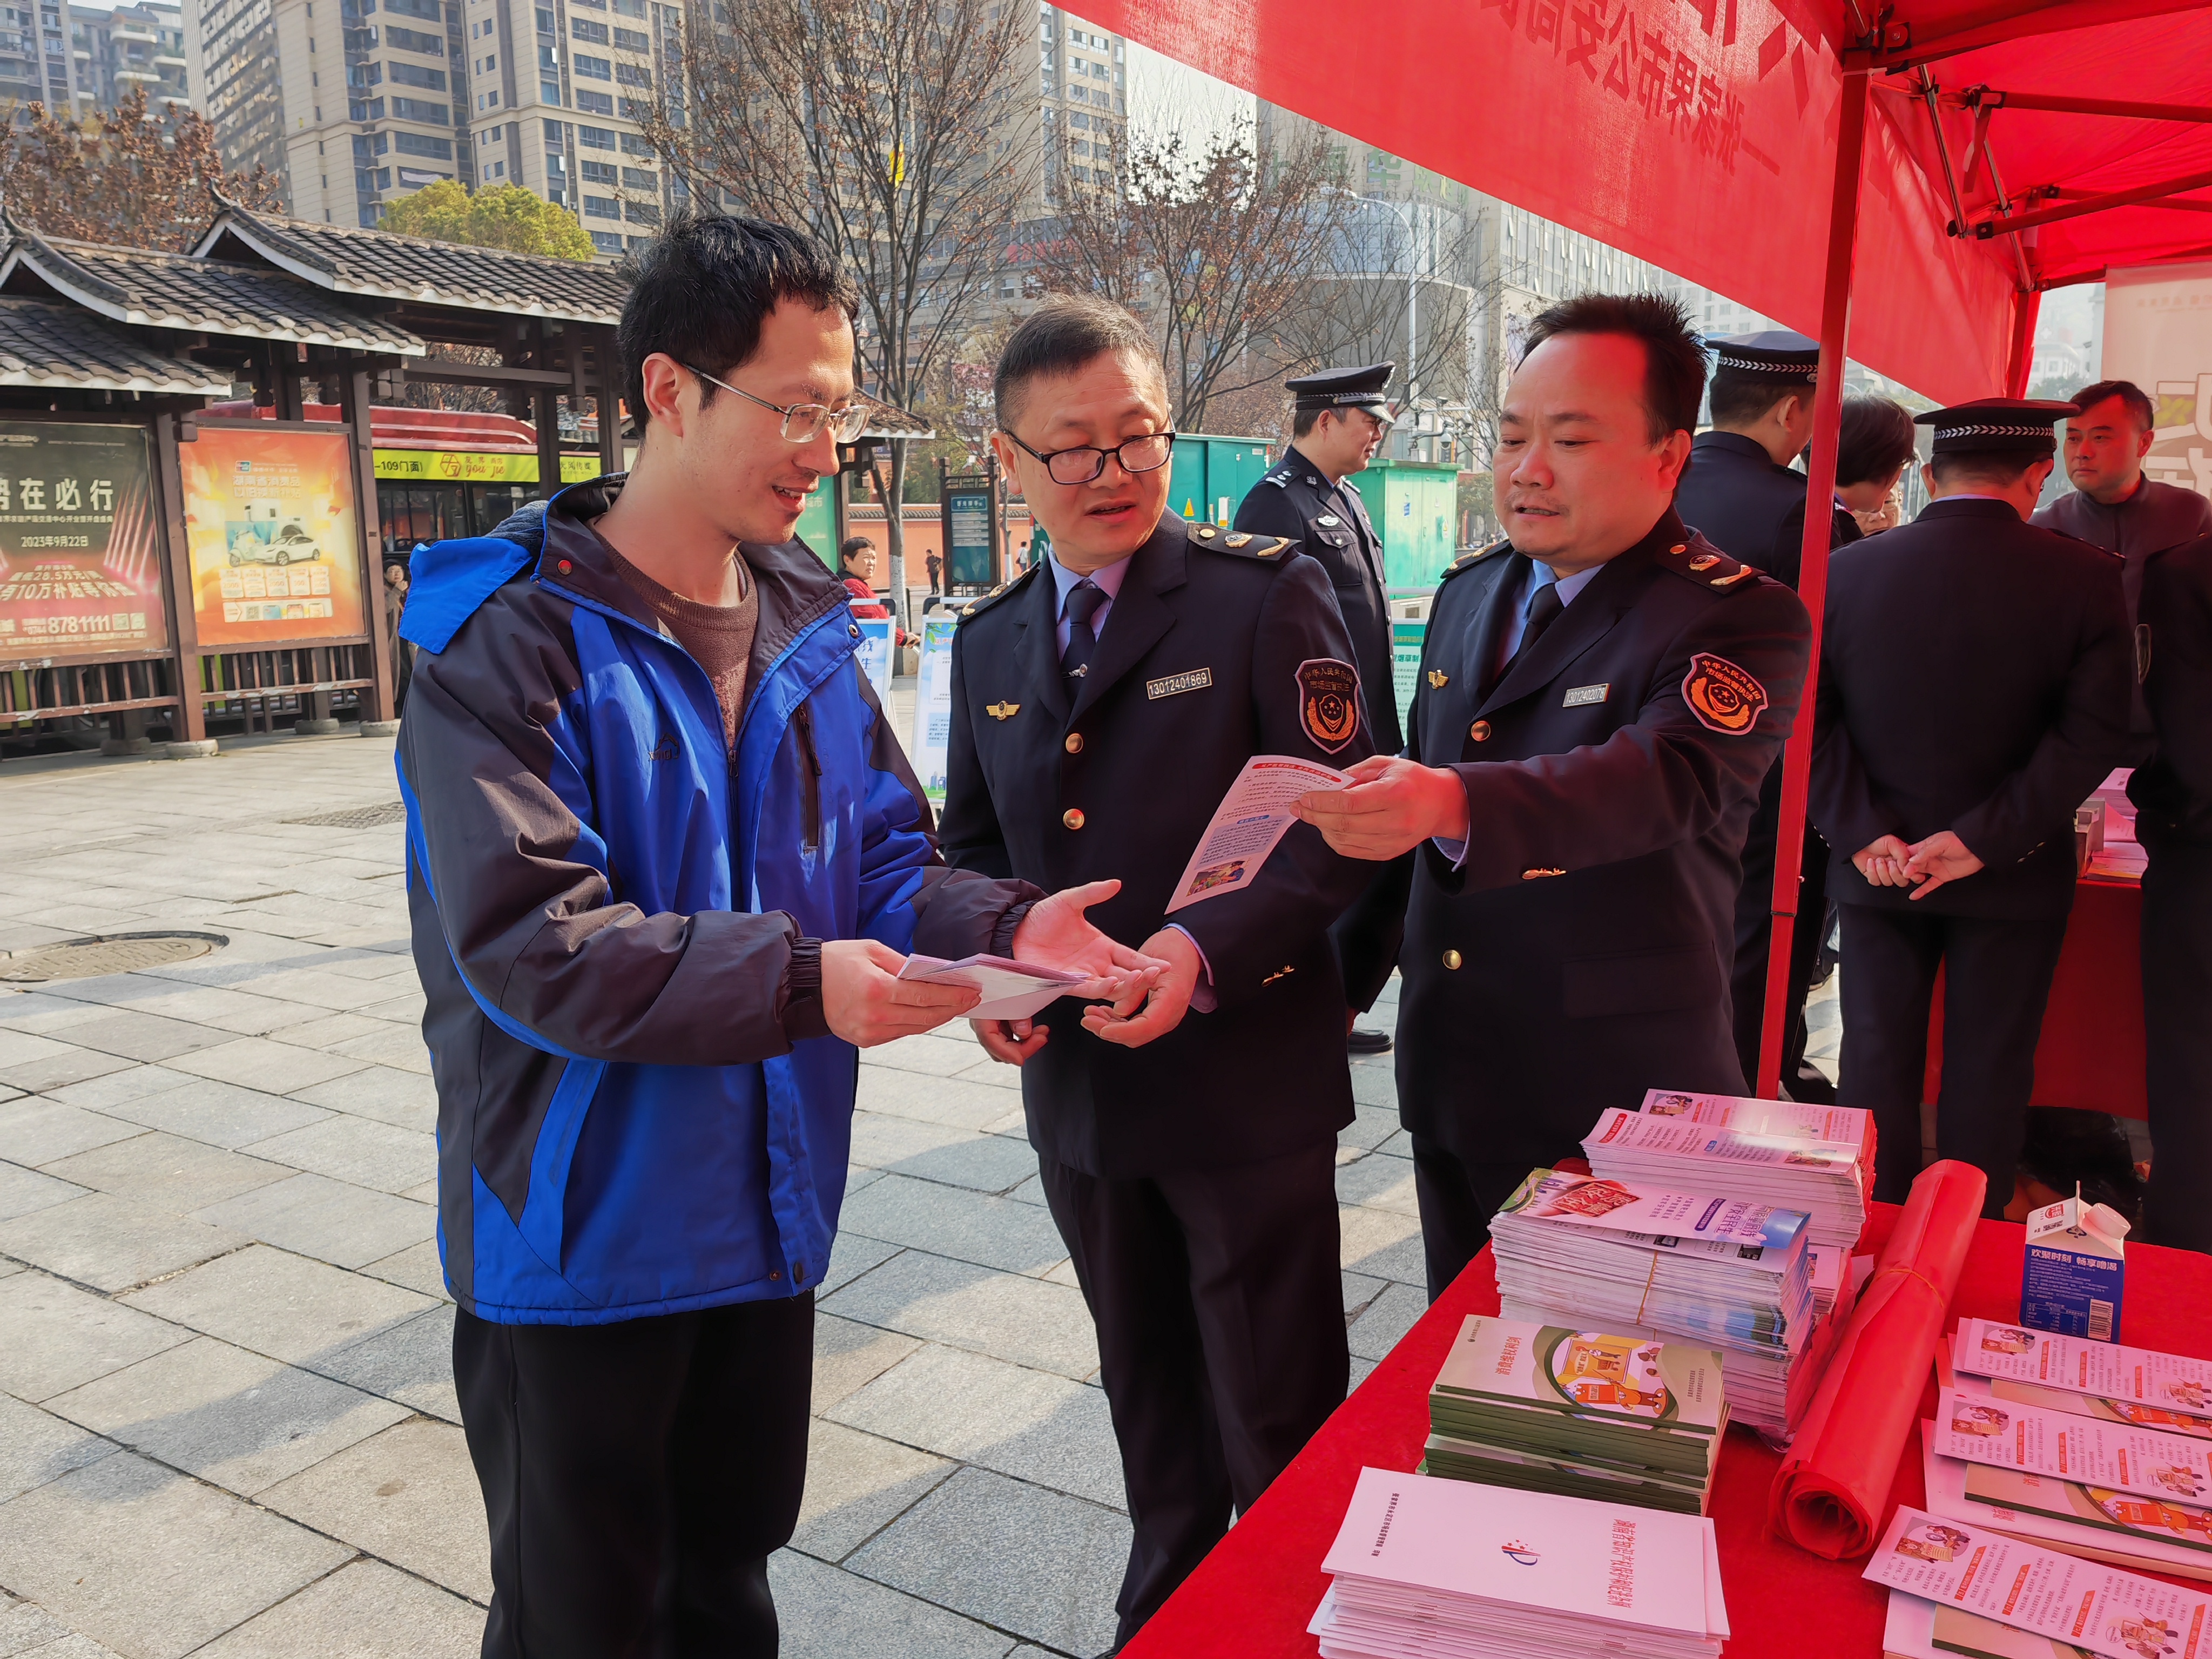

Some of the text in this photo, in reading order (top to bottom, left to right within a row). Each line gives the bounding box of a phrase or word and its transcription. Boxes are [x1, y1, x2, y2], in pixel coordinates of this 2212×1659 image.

[21, 535, 89, 547] 2023年9月22日
[48, 615, 110, 634] 8781111
[1149, 672, 1208, 696] 13012401869
[1701, 659, 1761, 700] 中华人民共和国
[1705, 667, 1755, 703] 市场监管执法
[2031, 1249, 2072, 1264] 欢聚时刻
[1494, 1336, 1522, 1376] 消费维权利剑
[1607, 1519, 1636, 1609] 湖南省知识产权保护和促进条例
